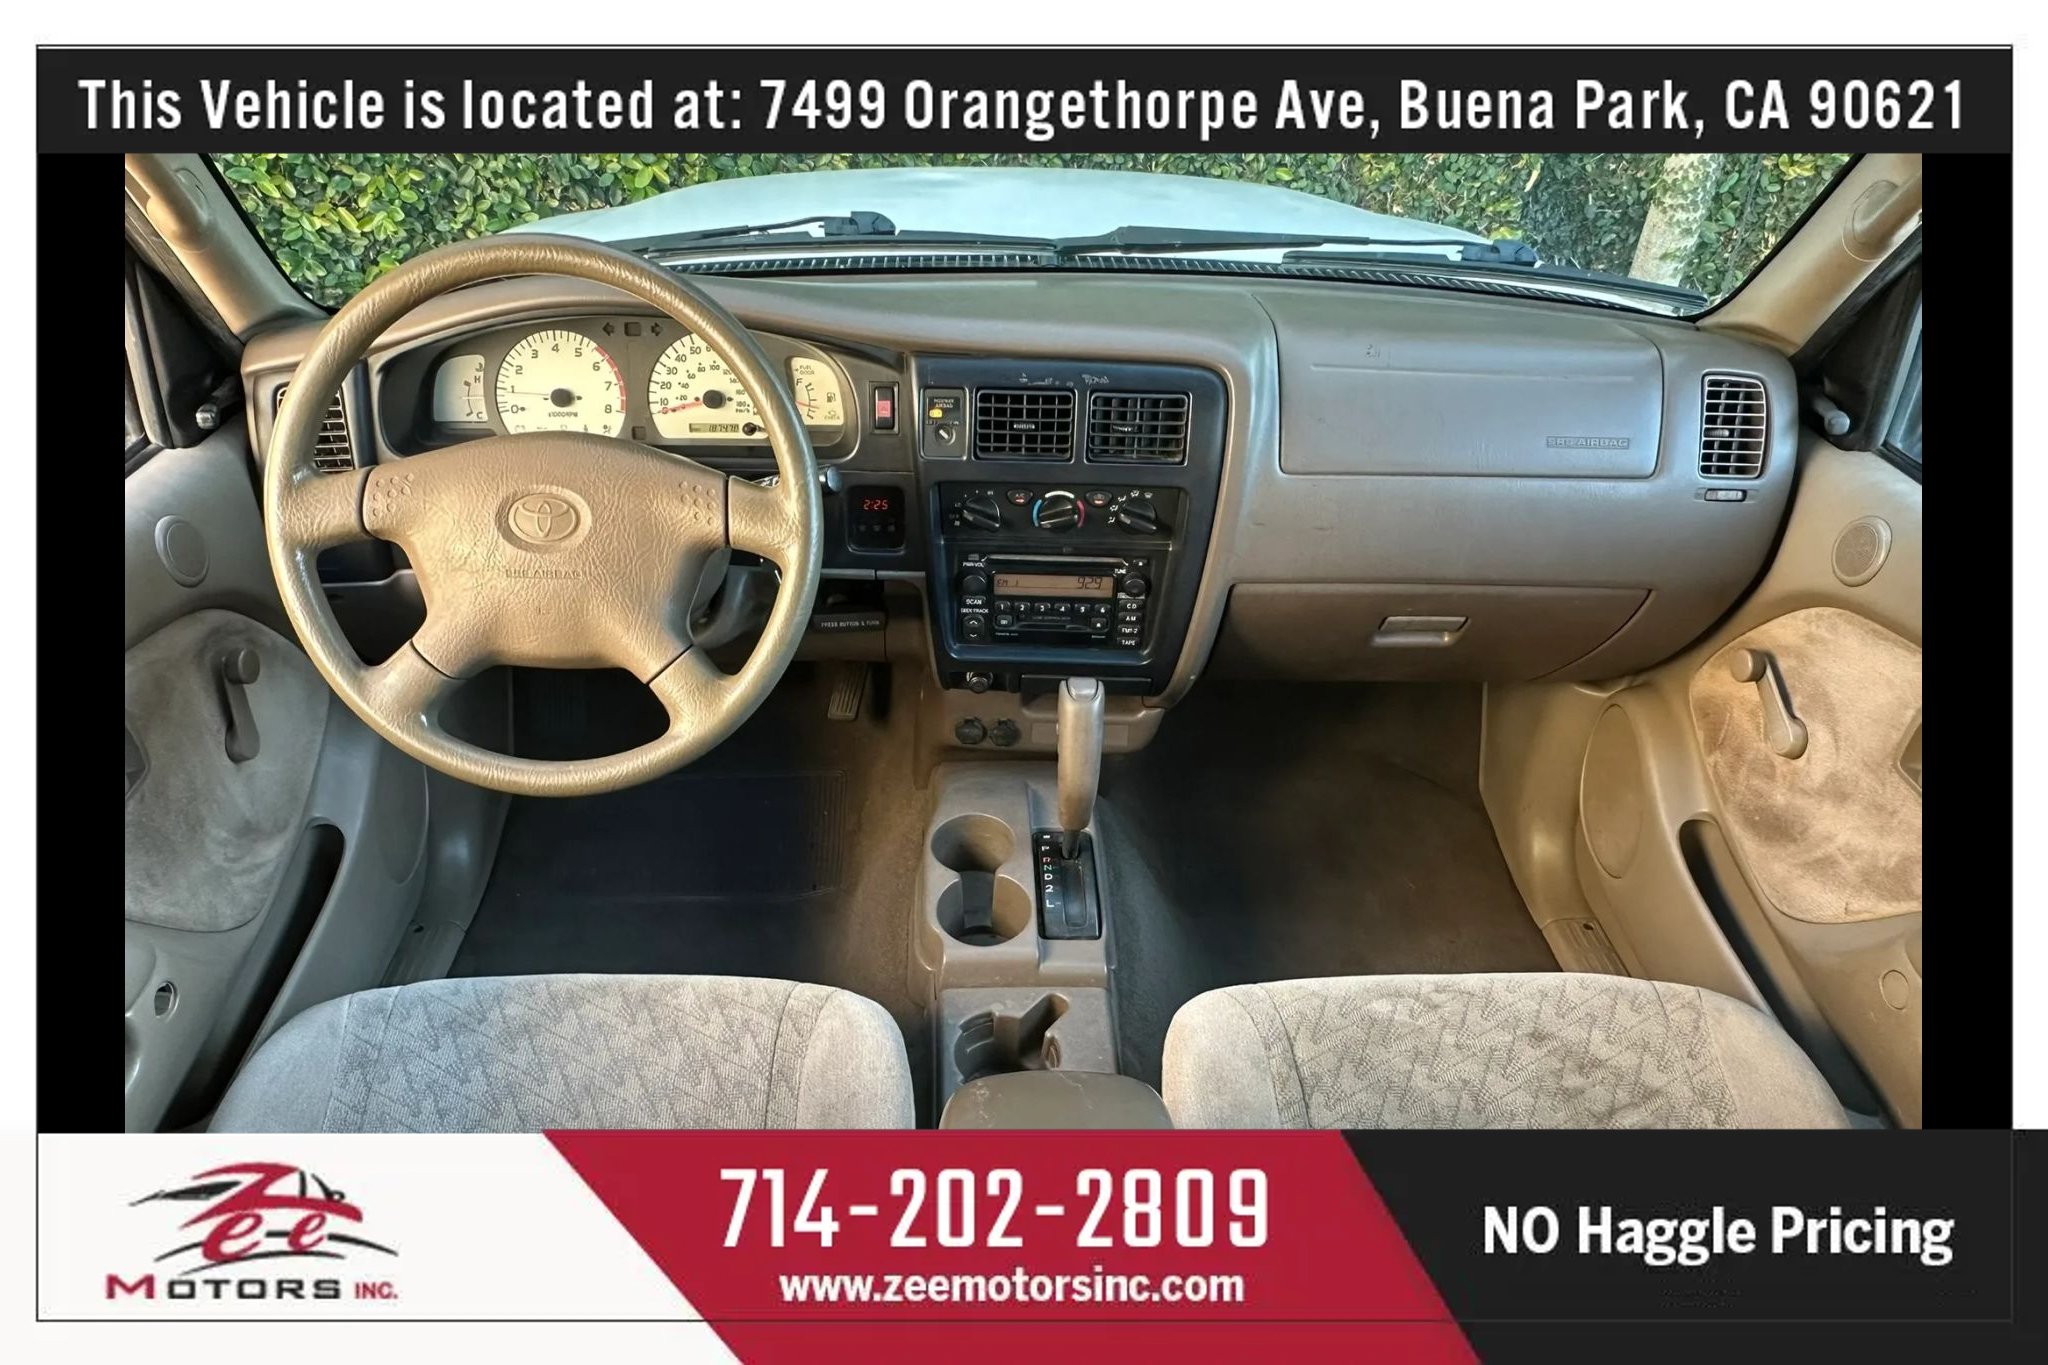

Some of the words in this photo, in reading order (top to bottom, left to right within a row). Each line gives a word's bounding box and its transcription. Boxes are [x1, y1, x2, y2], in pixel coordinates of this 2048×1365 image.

[552, 343, 560, 352] 4
[690, 346, 701, 355] 50
[531, 349, 539, 358] 3
[575, 348, 582, 357] 5
[674, 354, 687, 363] 40
[515, 365, 523, 375] 2
[592, 362, 600, 371] 6
[666, 366, 678, 375] 30
[474, 375, 481, 383] H
[796, 378, 803, 386] F
[605, 381, 612, 390] 7
[660, 381, 672, 390] 20
[660, 397, 669, 406] 10
[604, 404, 612, 414] 8
[1579, 438, 1628, 448] AIRBAG
[863, 499, 889, 511] 2:25
[821, 620, 838, 628] PRESS
[839, 620, 860, 628] BUTTON
[1045, 884, 1054, 892] 2
[1046, 899, 1055, 908] L
